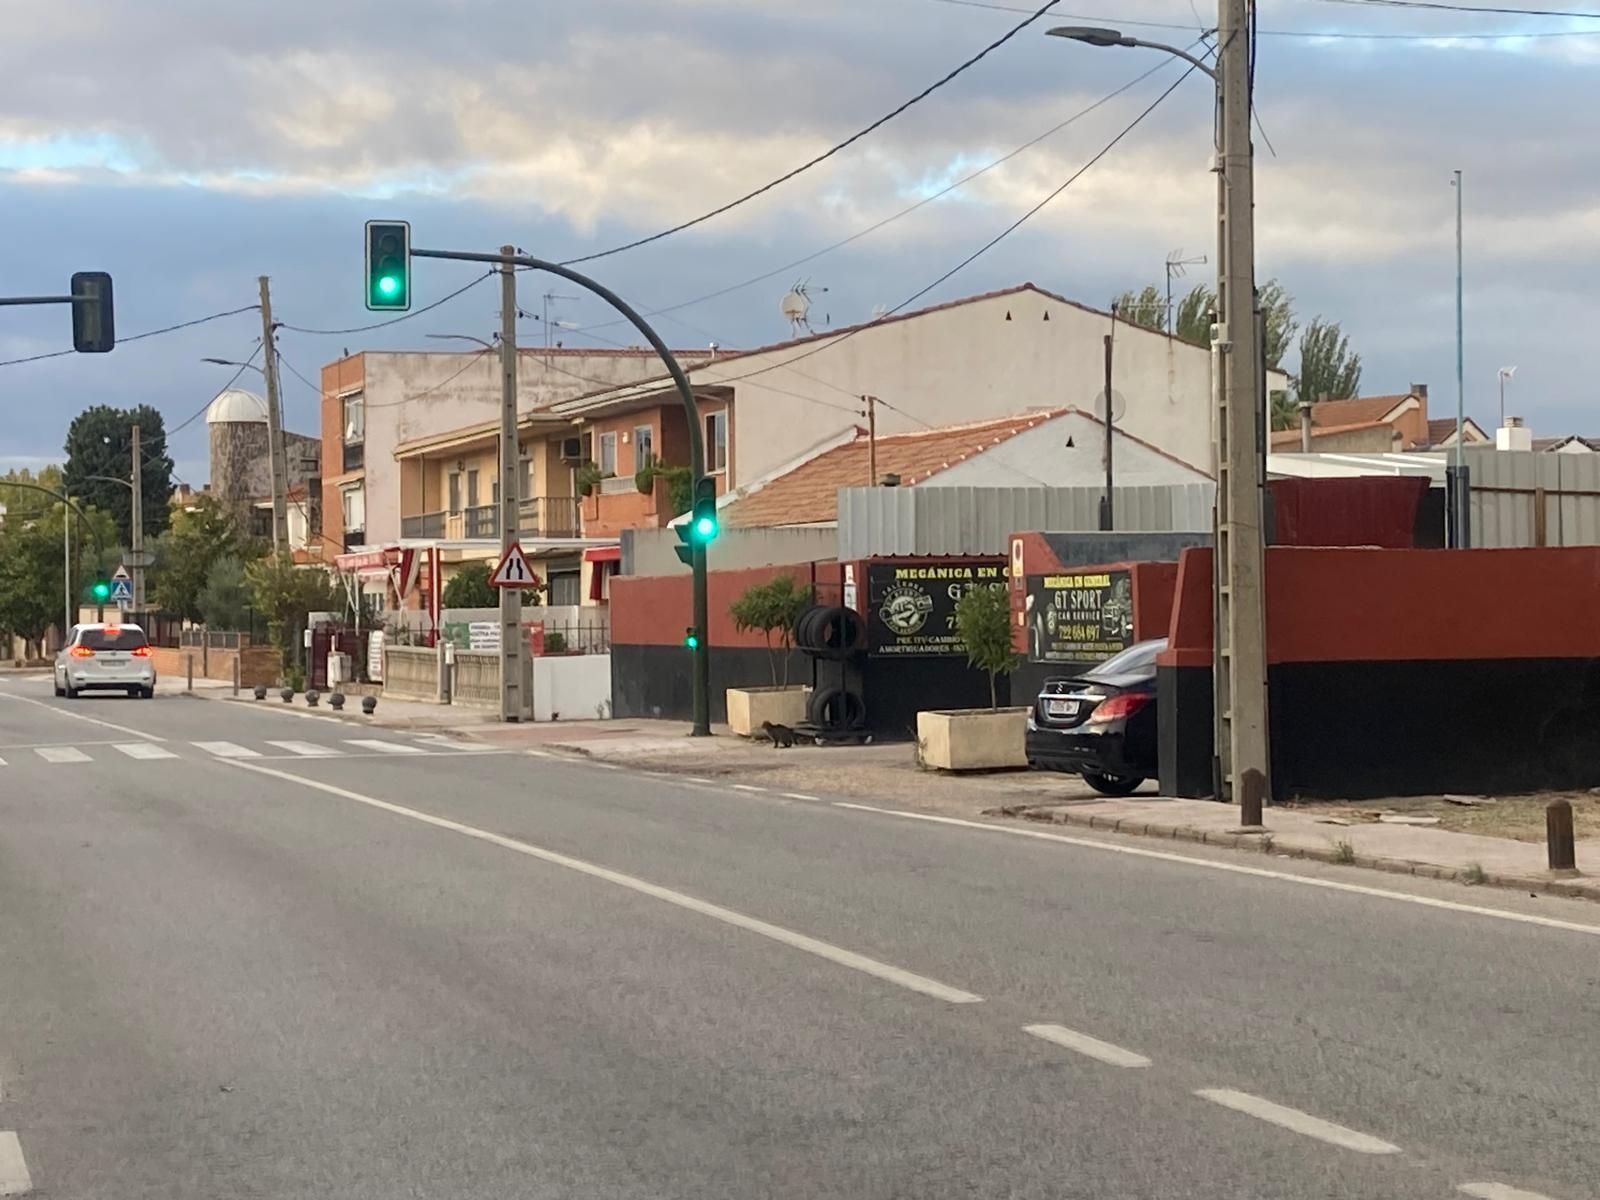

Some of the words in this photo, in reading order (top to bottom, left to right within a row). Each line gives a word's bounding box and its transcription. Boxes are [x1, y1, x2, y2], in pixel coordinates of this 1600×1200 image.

[896, 566, 972, 579] MECÁNICA
[977, 567, 997, 578] EN
[1055, 590, 1068, 609] GT
[1071, 589, 1102, 609] SPORT
